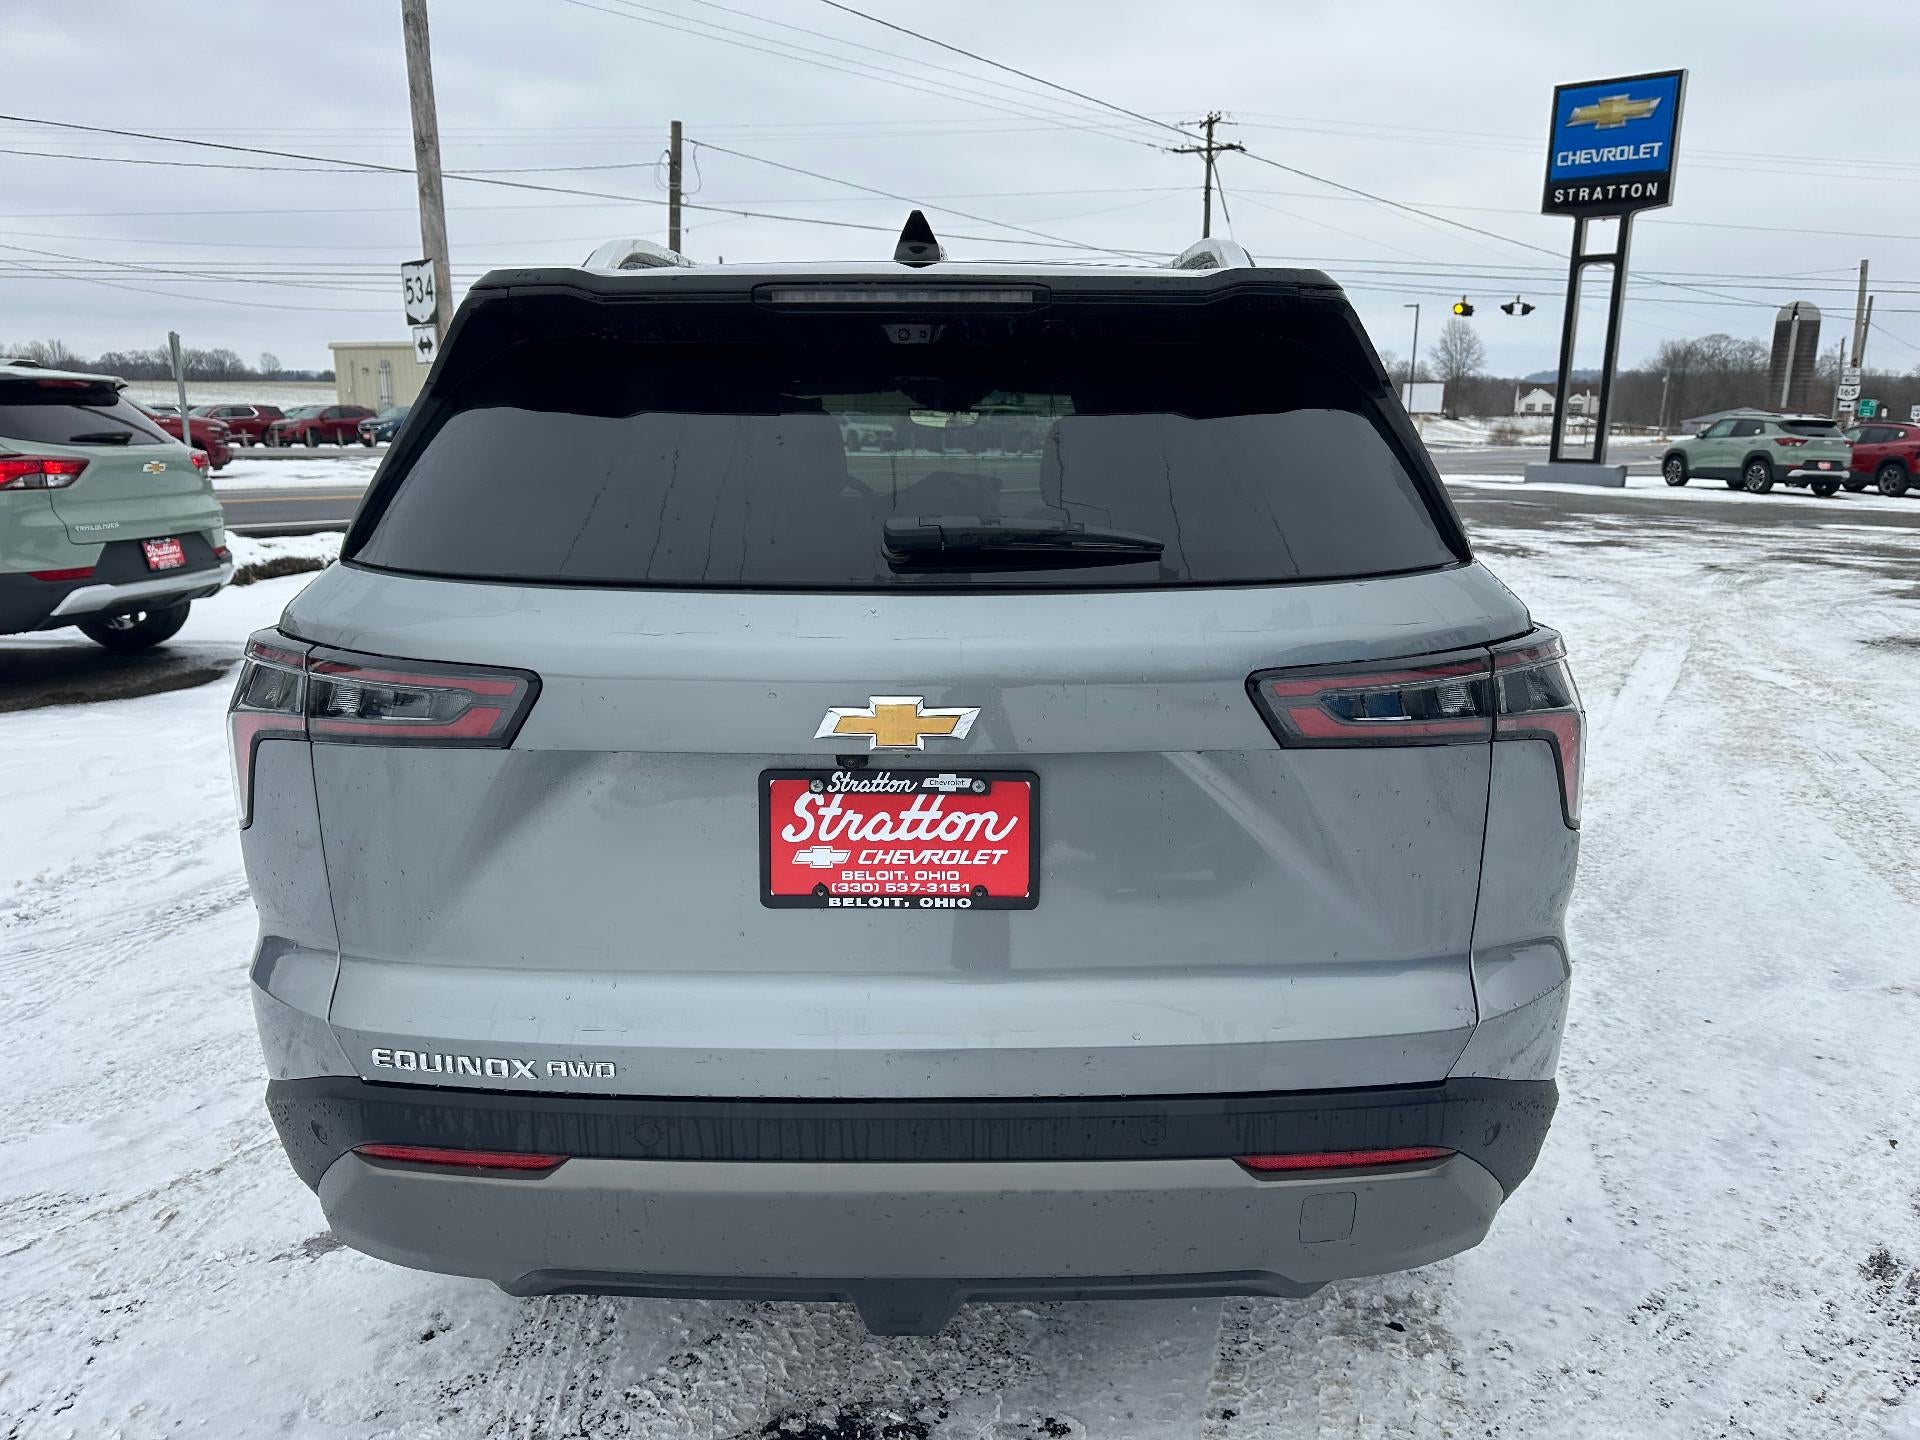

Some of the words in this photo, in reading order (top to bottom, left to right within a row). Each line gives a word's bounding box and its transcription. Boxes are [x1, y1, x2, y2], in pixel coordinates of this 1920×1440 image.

[1557, 142, 1663, 167] CHEVROLET
[1554, 182, 1659, 203] STRATTON
[405, 273, 434, 305] 534
[1840, 387, 1857, 396] 165
[827, 771, 918, 793] Stratton
[781, 791, 1018, 842] Stratton
[857, 849, 1009, 865] CHEVROLET
[841, 870, 909, 881] BELOIT,
[914, 870, 960, 881] OHIO
[831, 883, 880, 893] (330)
[885, 883, 971, 893] 537-3151
[828, 897, 910, 908] BELOIT,
[919, 897, 972, 908] OHIO
[371, 1048, 539, 1080] EQUINOX
[546, 1061, 617, 1079] AWD
